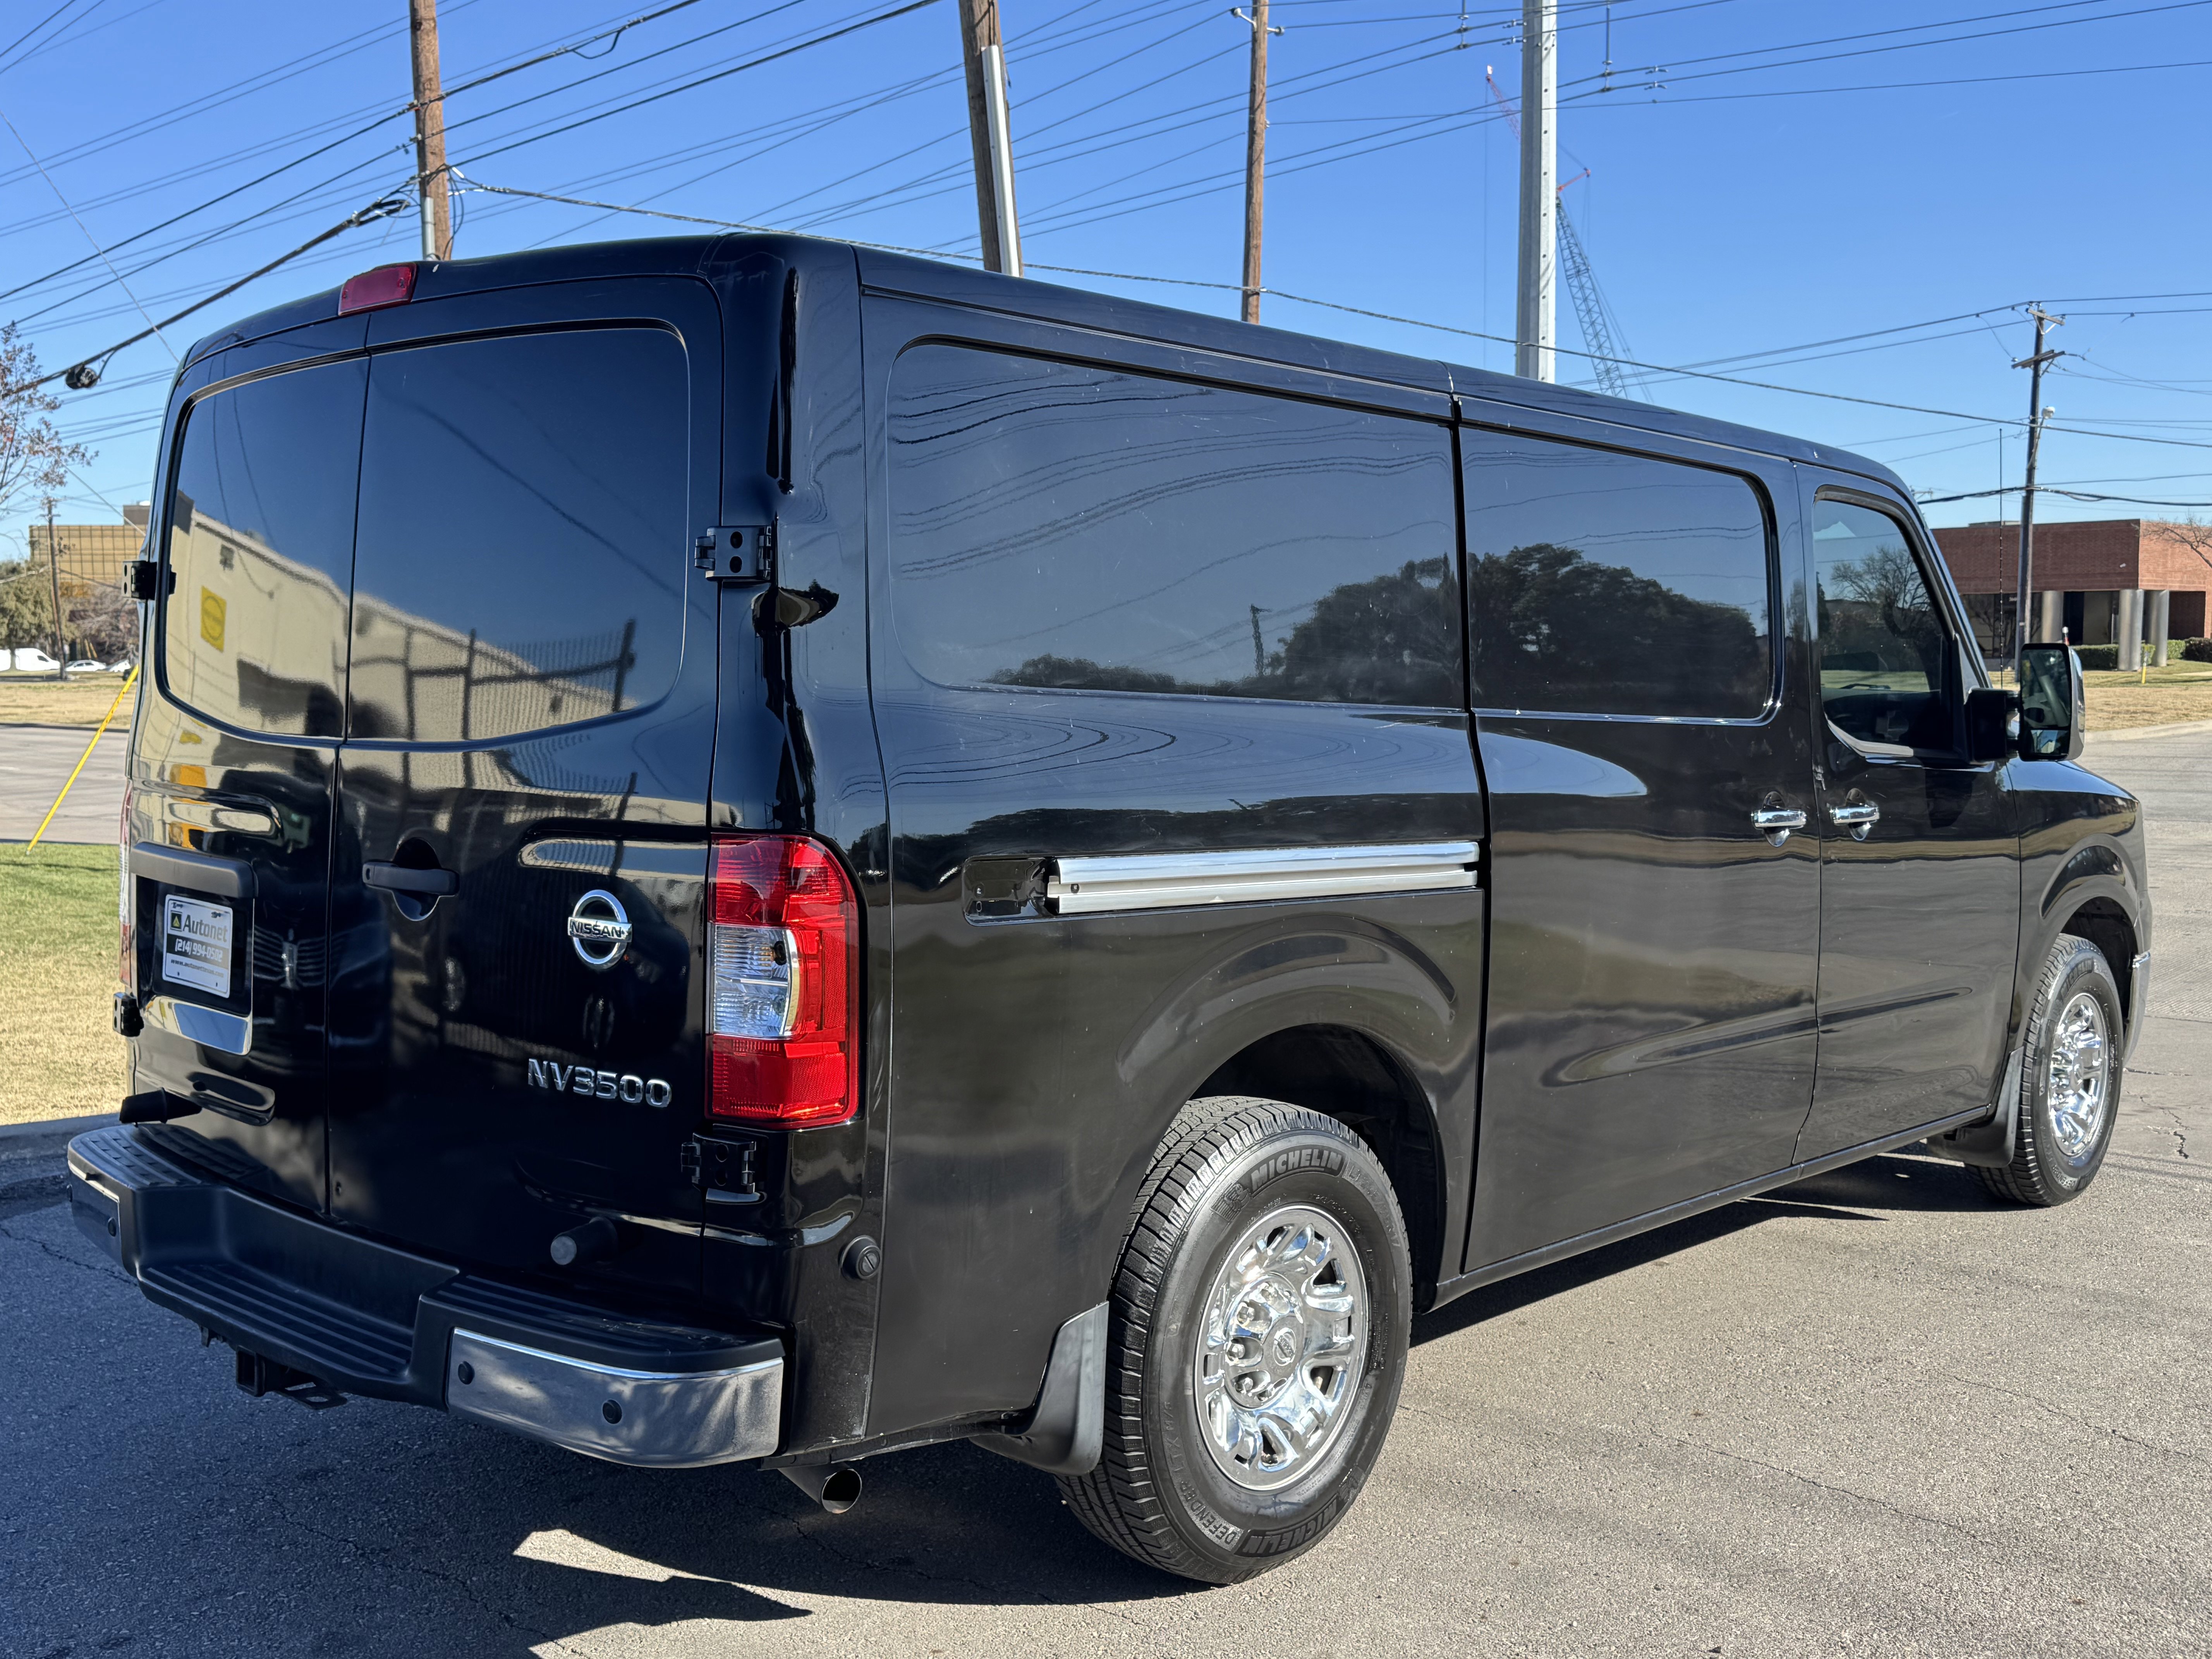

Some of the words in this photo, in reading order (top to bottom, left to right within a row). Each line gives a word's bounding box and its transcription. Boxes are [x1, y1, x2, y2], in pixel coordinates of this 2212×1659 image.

[183, 914, 228, 943] Autonet
[570, 921, 623, 938] NISSAN
[175, 938, 192, 955] (214)
[193, 943, 223, 962] 994-0502
[528, 1058, 672, 1108] NV3500
[1251, 1149, 1343, 1191] MICHELIN
[1180, 1480, 1237, 1545] DEFENDER
[1242, 1498, 1338, 1553] MICHELIN
